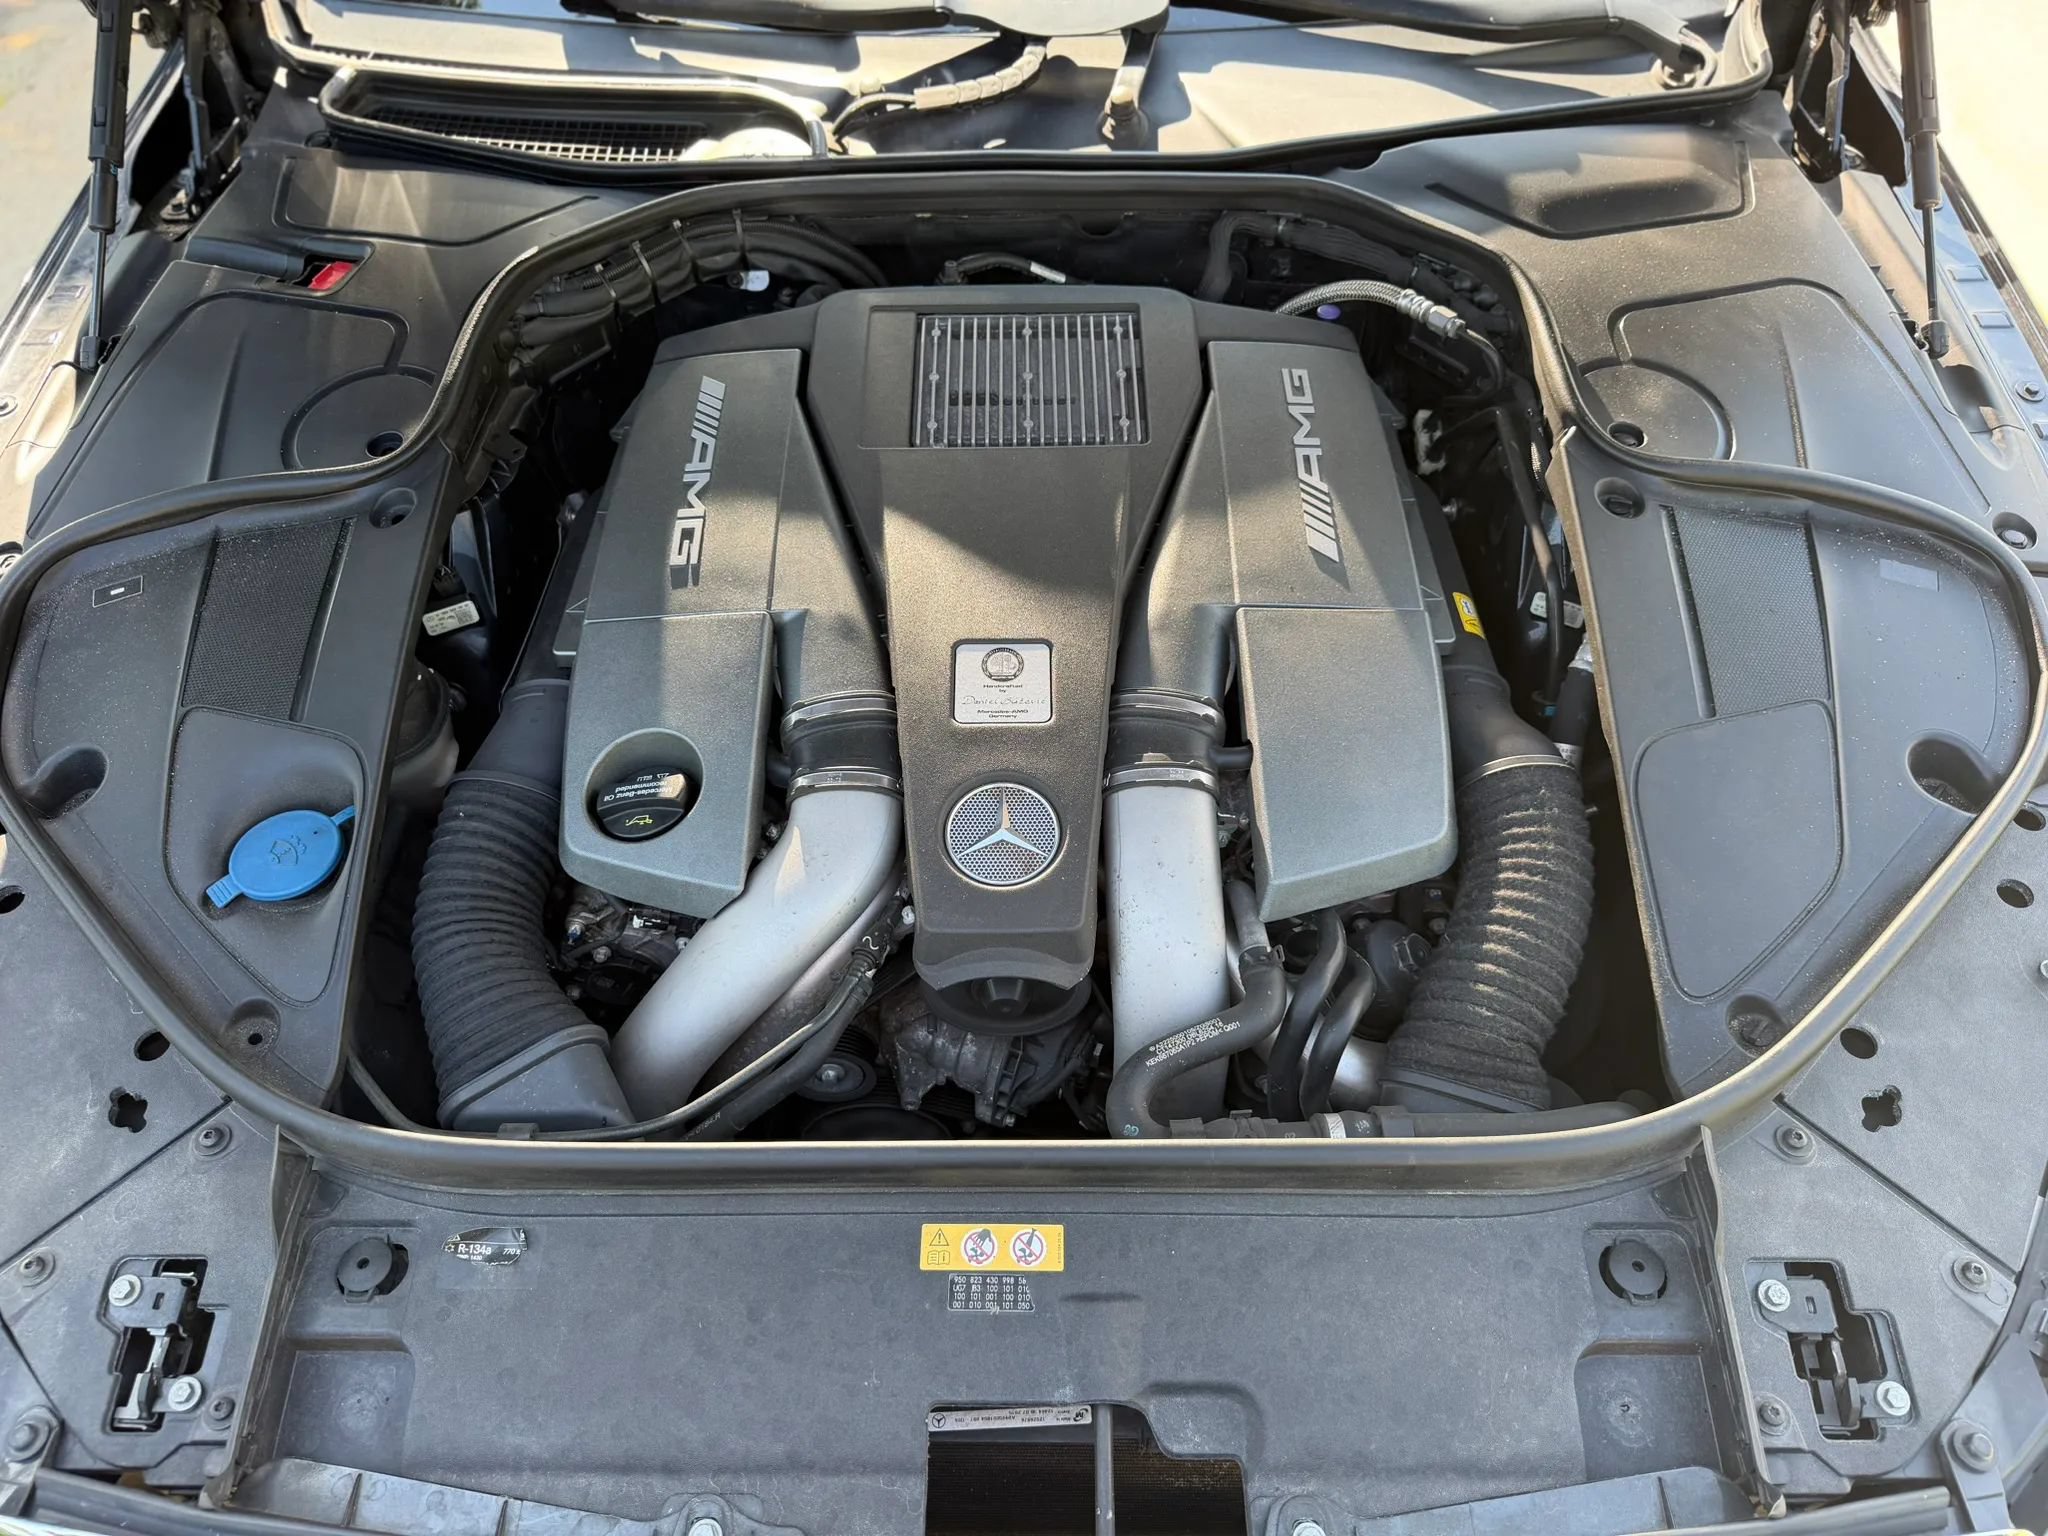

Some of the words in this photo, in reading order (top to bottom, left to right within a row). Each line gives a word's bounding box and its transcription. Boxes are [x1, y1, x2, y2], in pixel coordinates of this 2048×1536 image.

[614, 780, 668, 793] recommended
[603, 794, 615, 802] Oil
[457, 1243, 492, 1255] R-134a
[954, 1276, 967, 1284] 950
[986, 1276, 999, 1284] 430
[1002, 1276, 1014, 1284] 998
[986, 1284, 999, 1292] 100
[1003, 1284, 1014, 1293] 101
[954, 1292, 966, 1300] 100
[970, 1292, 981, 1300] 101
[985, 1293, 998, 1301] 001
[1002, 1293, 1014, 1301] 100
[1017, 1293, 1031, 1301] 010
[952, 1301, 965, 1309] 001
[968, 1301, 982, 1309] 010
[985, 1301, 997, 1309] 001
[1002, 1301, 1014, 1309] 101
